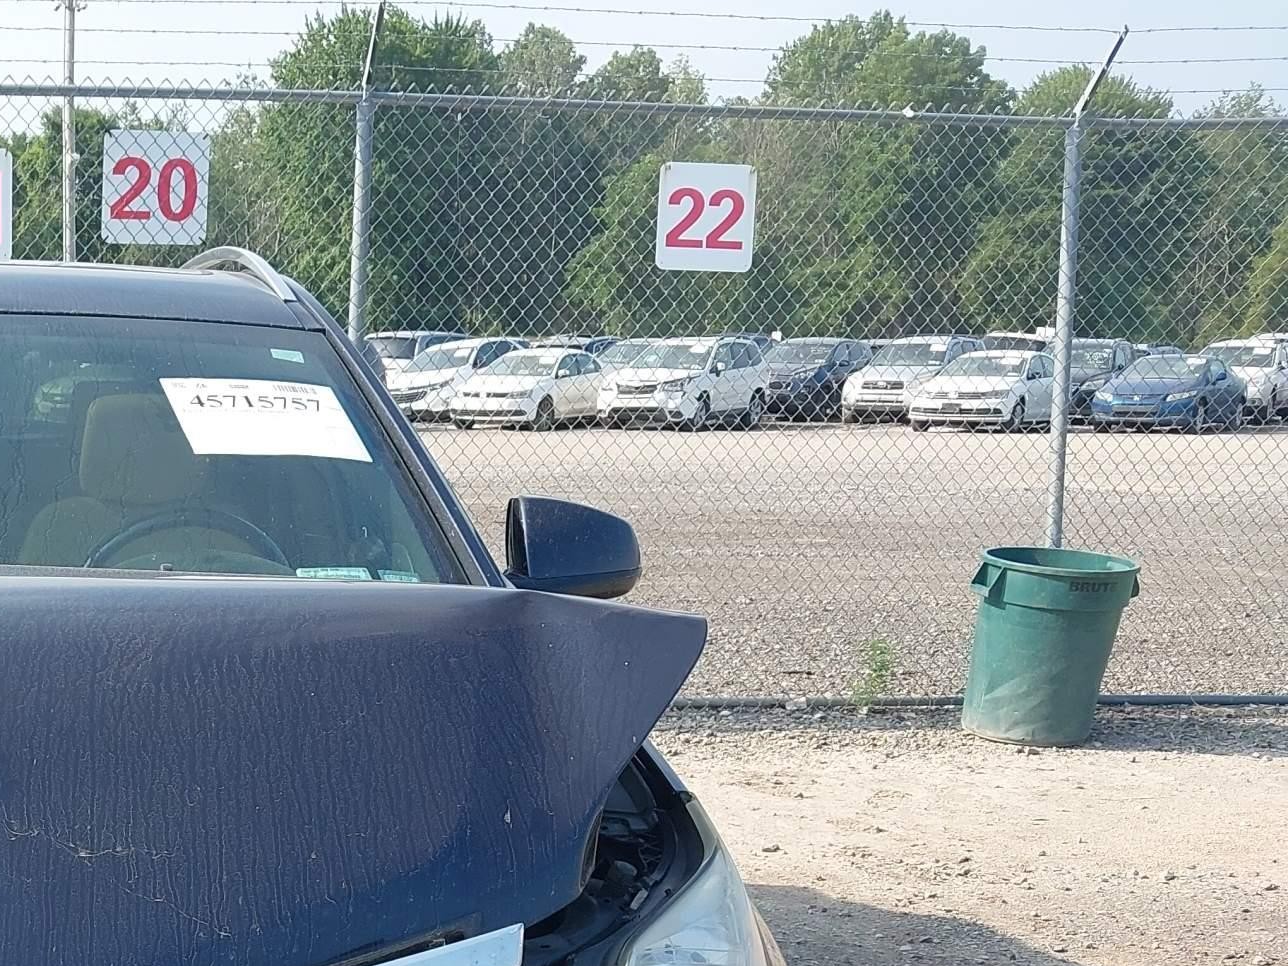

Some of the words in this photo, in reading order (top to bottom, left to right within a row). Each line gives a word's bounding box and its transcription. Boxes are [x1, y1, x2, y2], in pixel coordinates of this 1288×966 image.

[110, 156, 198, 222] 20
[665, 187, 745, 250] 22
[190, 394, 320, 413] 45715757
[1068, 581, 1119, 593] BRUTE
